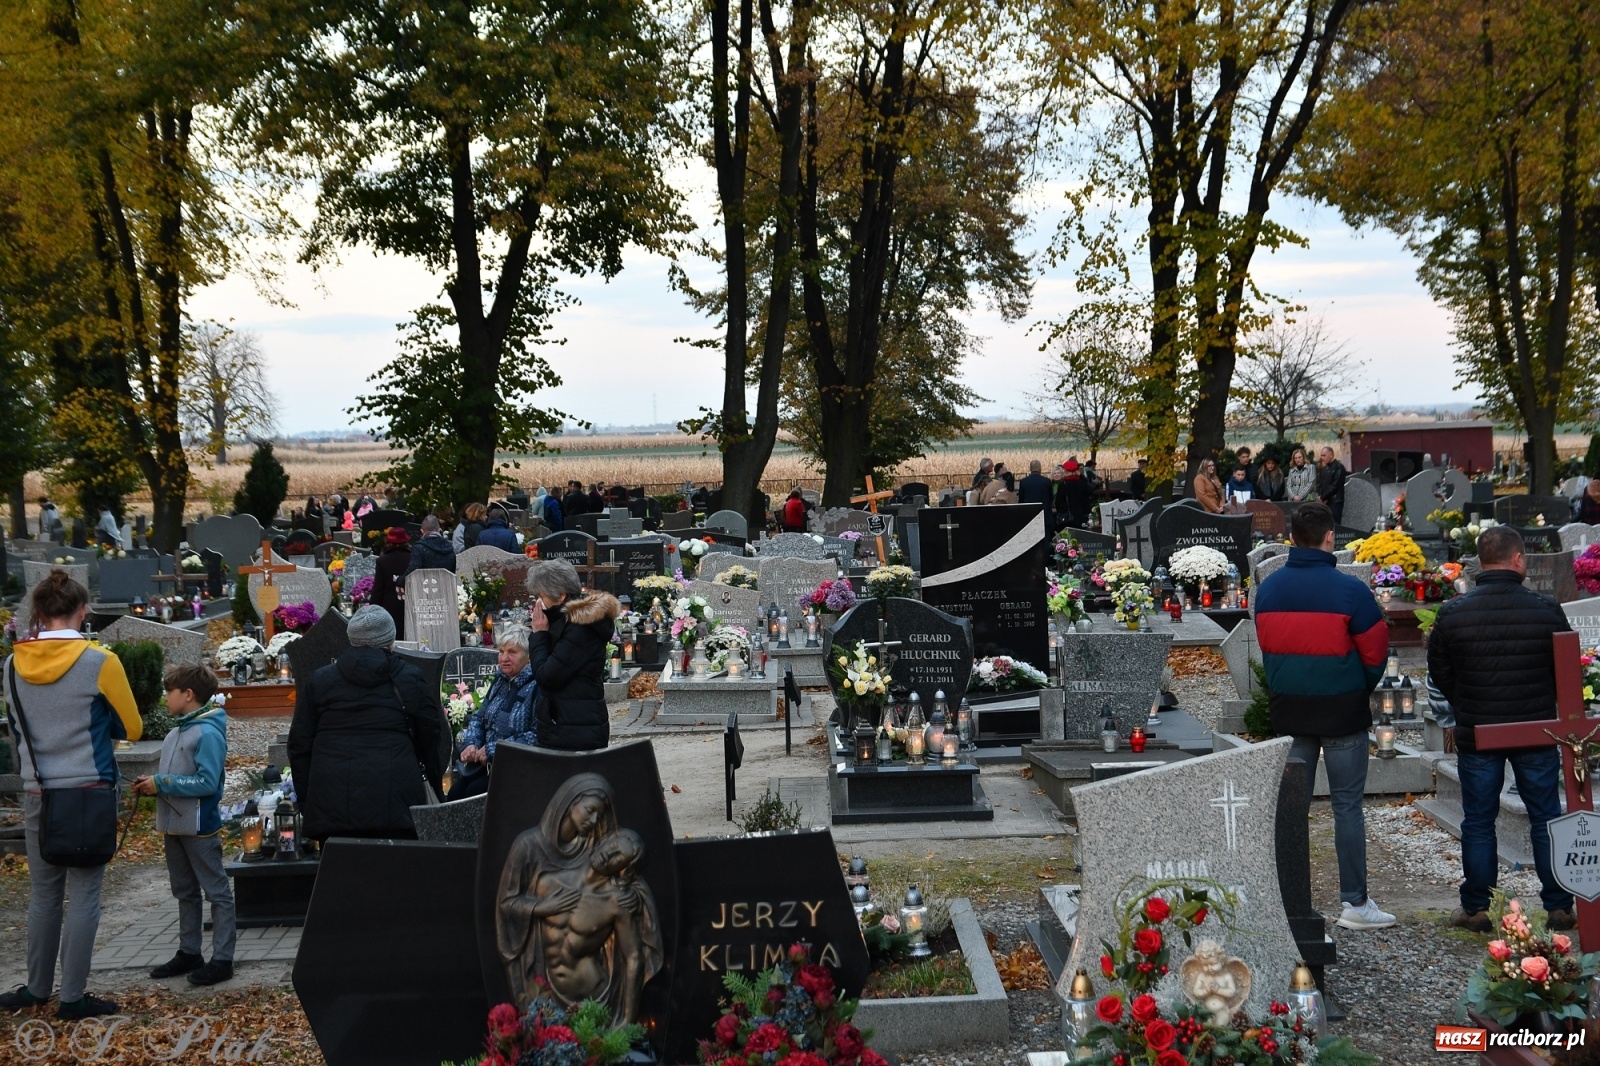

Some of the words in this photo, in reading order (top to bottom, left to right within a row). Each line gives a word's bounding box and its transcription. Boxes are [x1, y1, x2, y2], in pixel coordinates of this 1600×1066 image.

[1192, 527, 1219, 535] JANINA
[1175, 534, 1235, 545] ZWOLIŃSKA
[961, 590, 1007, 600] PŁACZEK
[935, 603, 973, 612] RYSTYNA
[1000, 601, 1031, 610] GERARD
[909, 633, 951, 643] GERARD
[899, 650, 961, 660] HLUCHNIK
[1571, 838, 1597, 848] Anna
[1146, 859, 1209, 879] MARIA
[711, 900, 824, 929] JERZY
